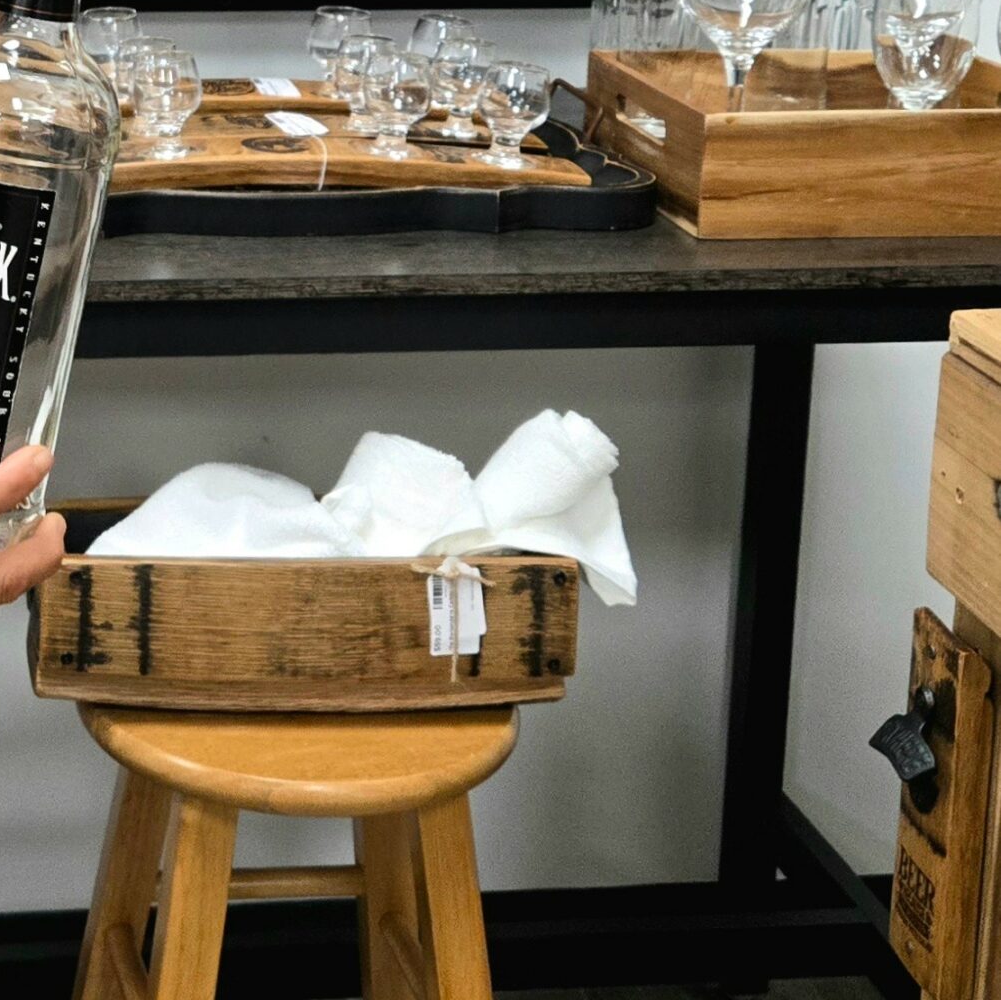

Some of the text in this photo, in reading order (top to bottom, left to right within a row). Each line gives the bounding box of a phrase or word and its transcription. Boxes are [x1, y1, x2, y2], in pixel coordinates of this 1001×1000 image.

[15, 201, 51, 334] KENTUCKY
[0, 355, 18, 416] SOUR
[899, 844, 936, 911] BEER
